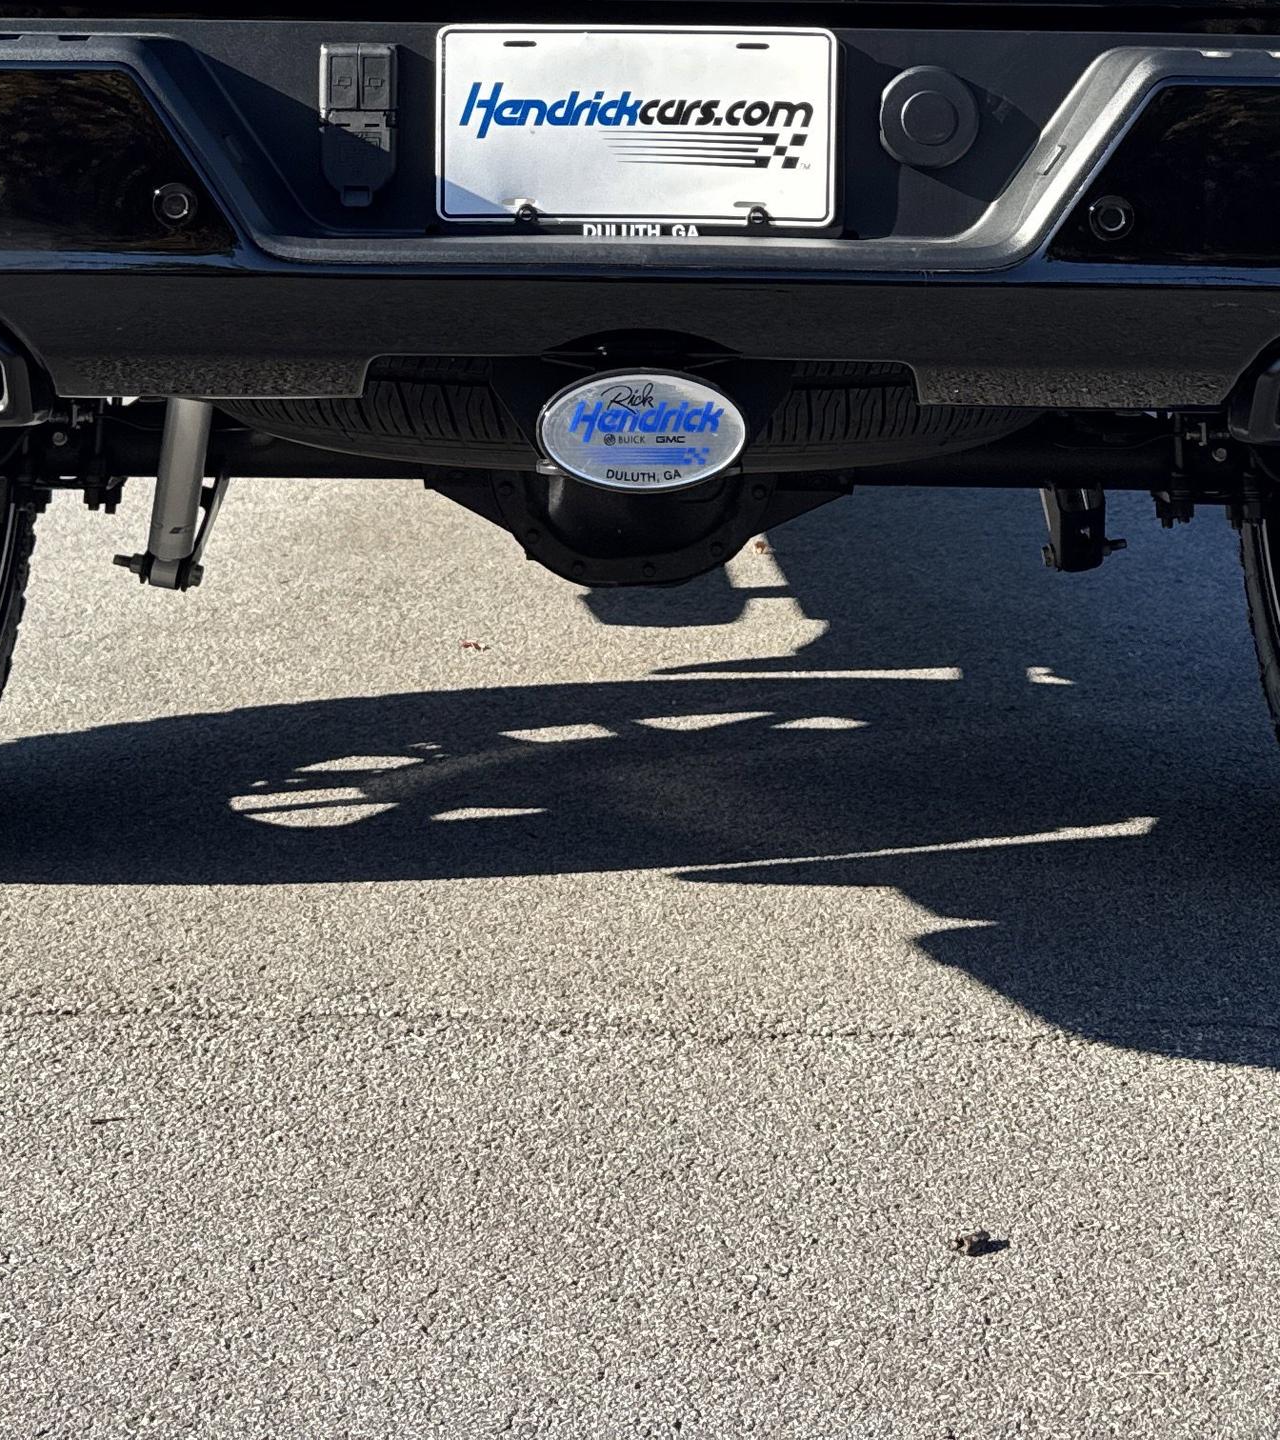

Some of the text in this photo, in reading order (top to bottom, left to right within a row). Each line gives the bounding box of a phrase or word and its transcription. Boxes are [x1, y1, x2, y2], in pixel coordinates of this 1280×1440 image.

[459, 82, 814, 139] Hendrickcars.com
[601, 383, 654, 414] Rick
[569, 400, 724, 443] Hendrick
[618, 434, 686, 444] BUICK GMC
[606, 469, 682, 483] DULUTH, GA
